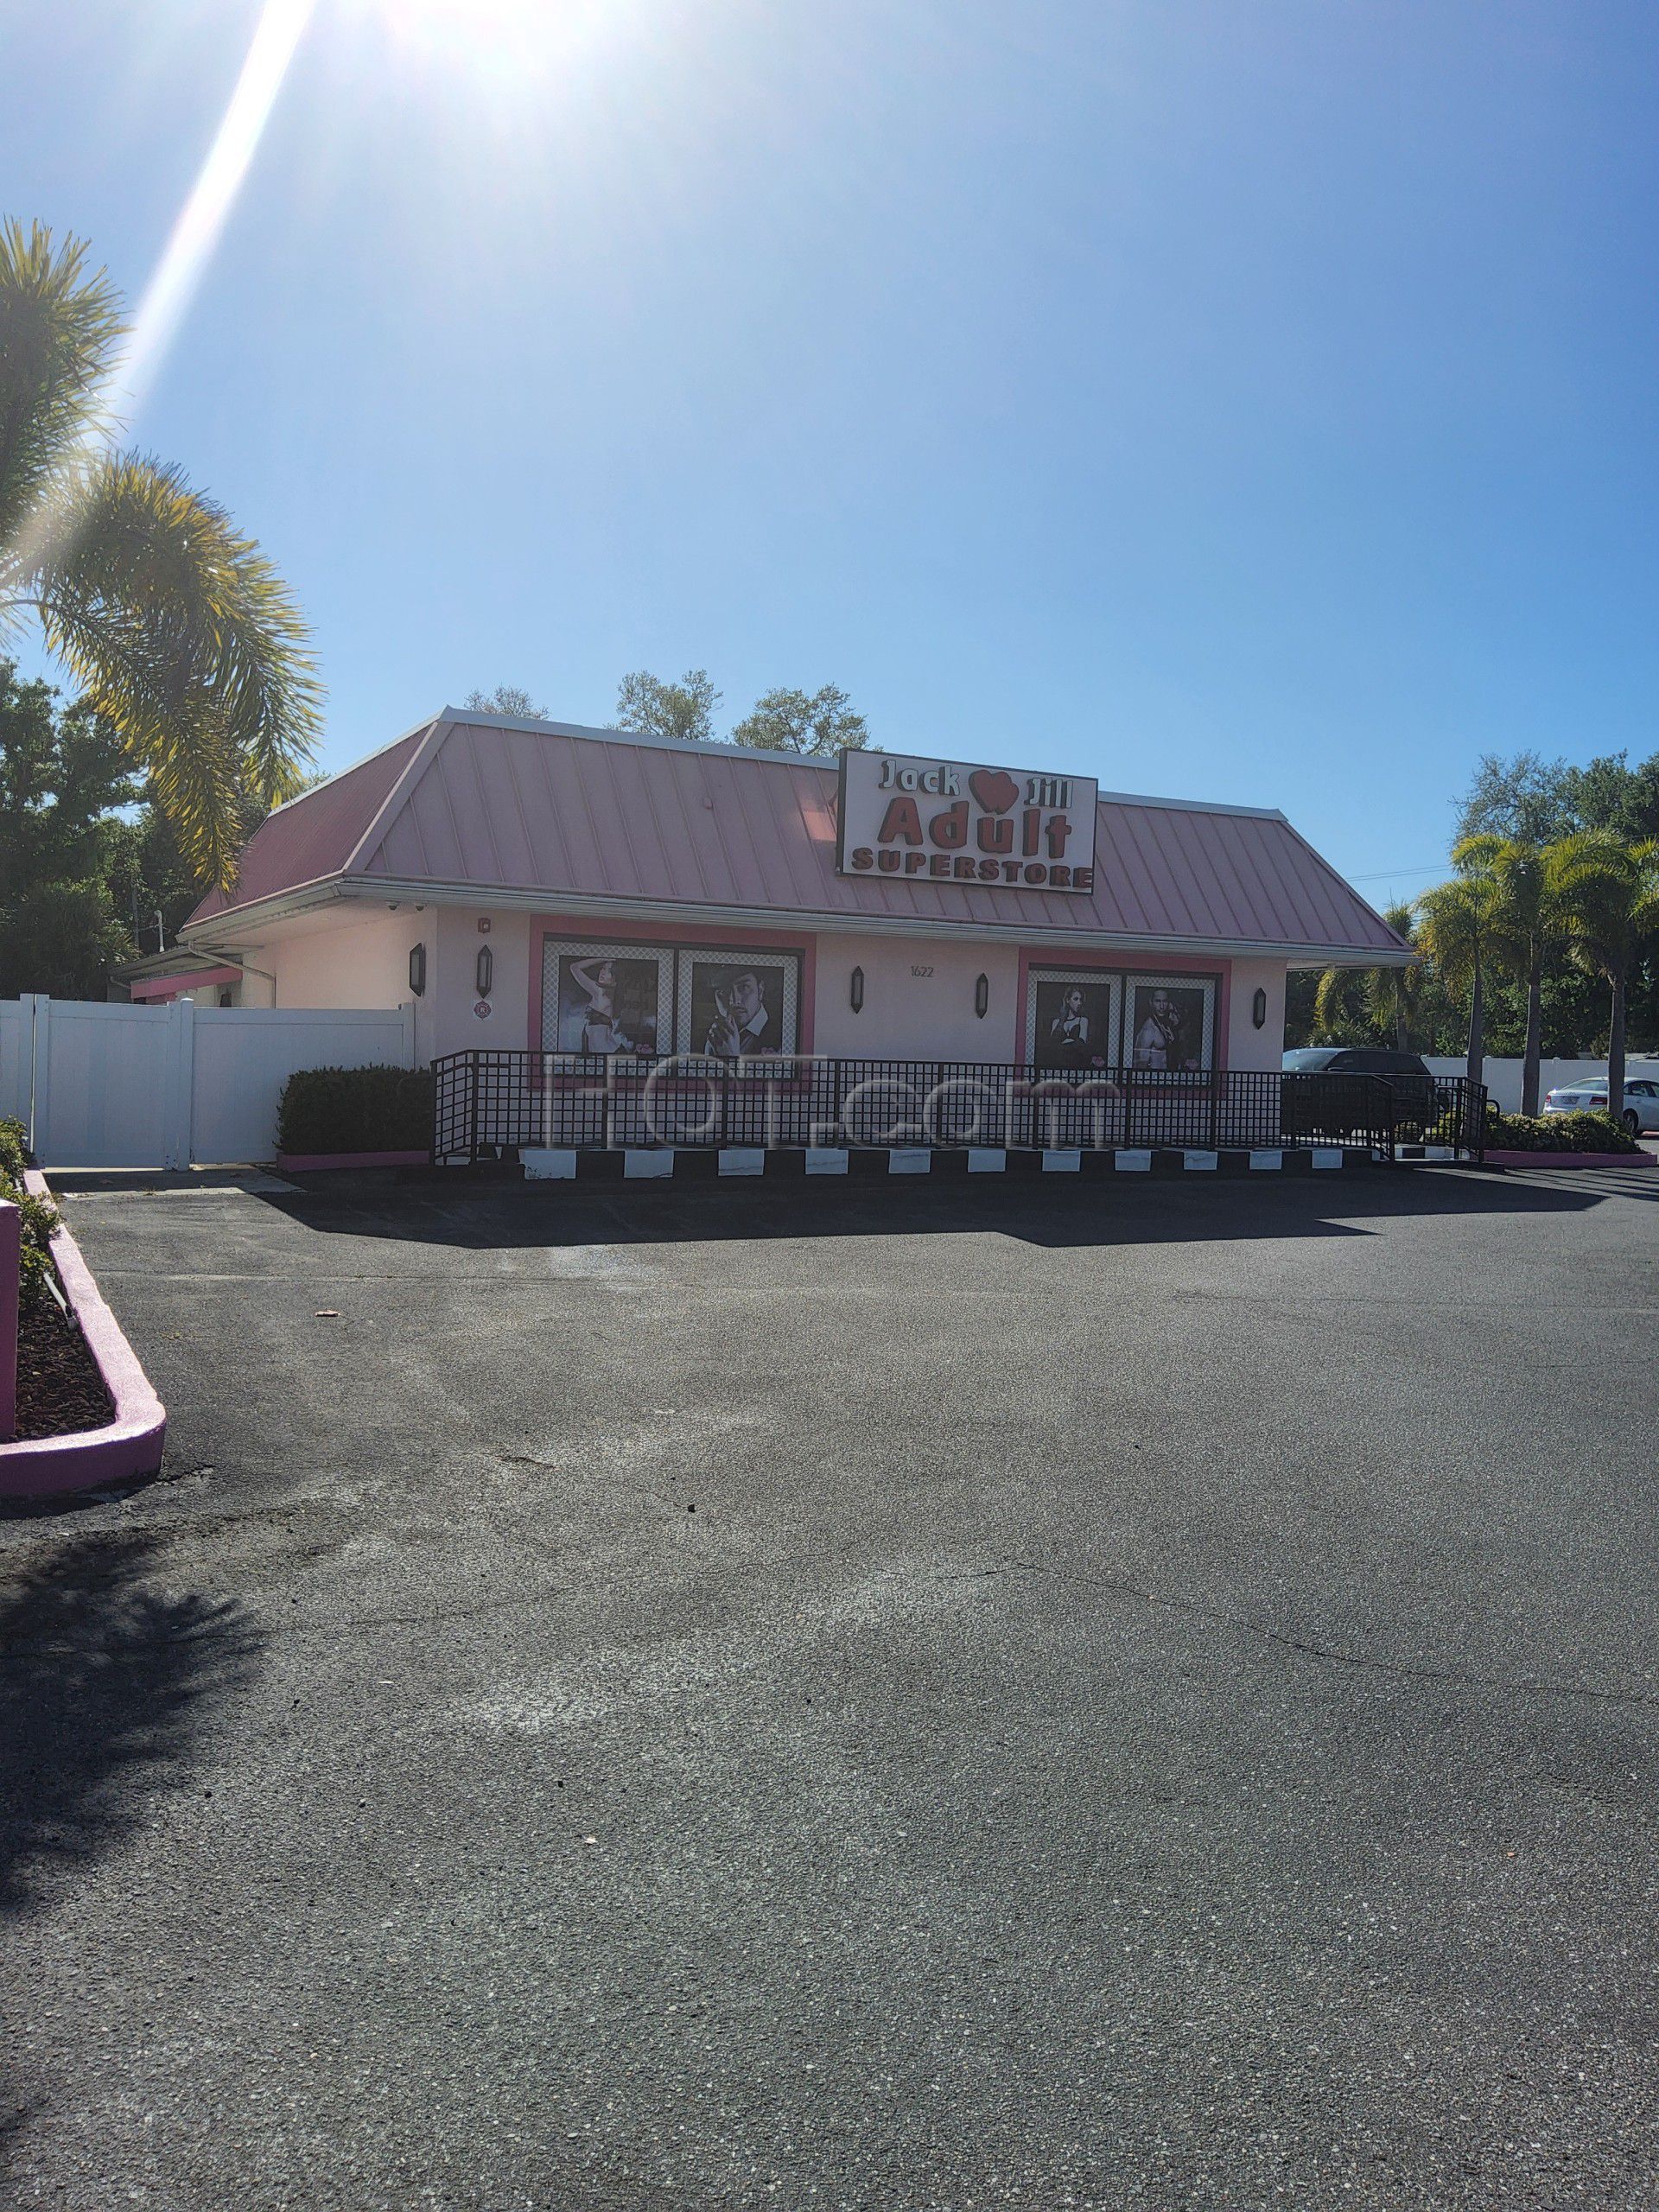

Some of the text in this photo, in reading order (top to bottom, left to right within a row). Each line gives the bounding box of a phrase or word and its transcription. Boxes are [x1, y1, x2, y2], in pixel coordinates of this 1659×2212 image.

[879, 760, 1073, 809] Jack Jill
[877, 797, 1072, 859] Adult
[851, 848, 1092, 888] SUPERSTORE
[911, 966, 933, 977] 1622
